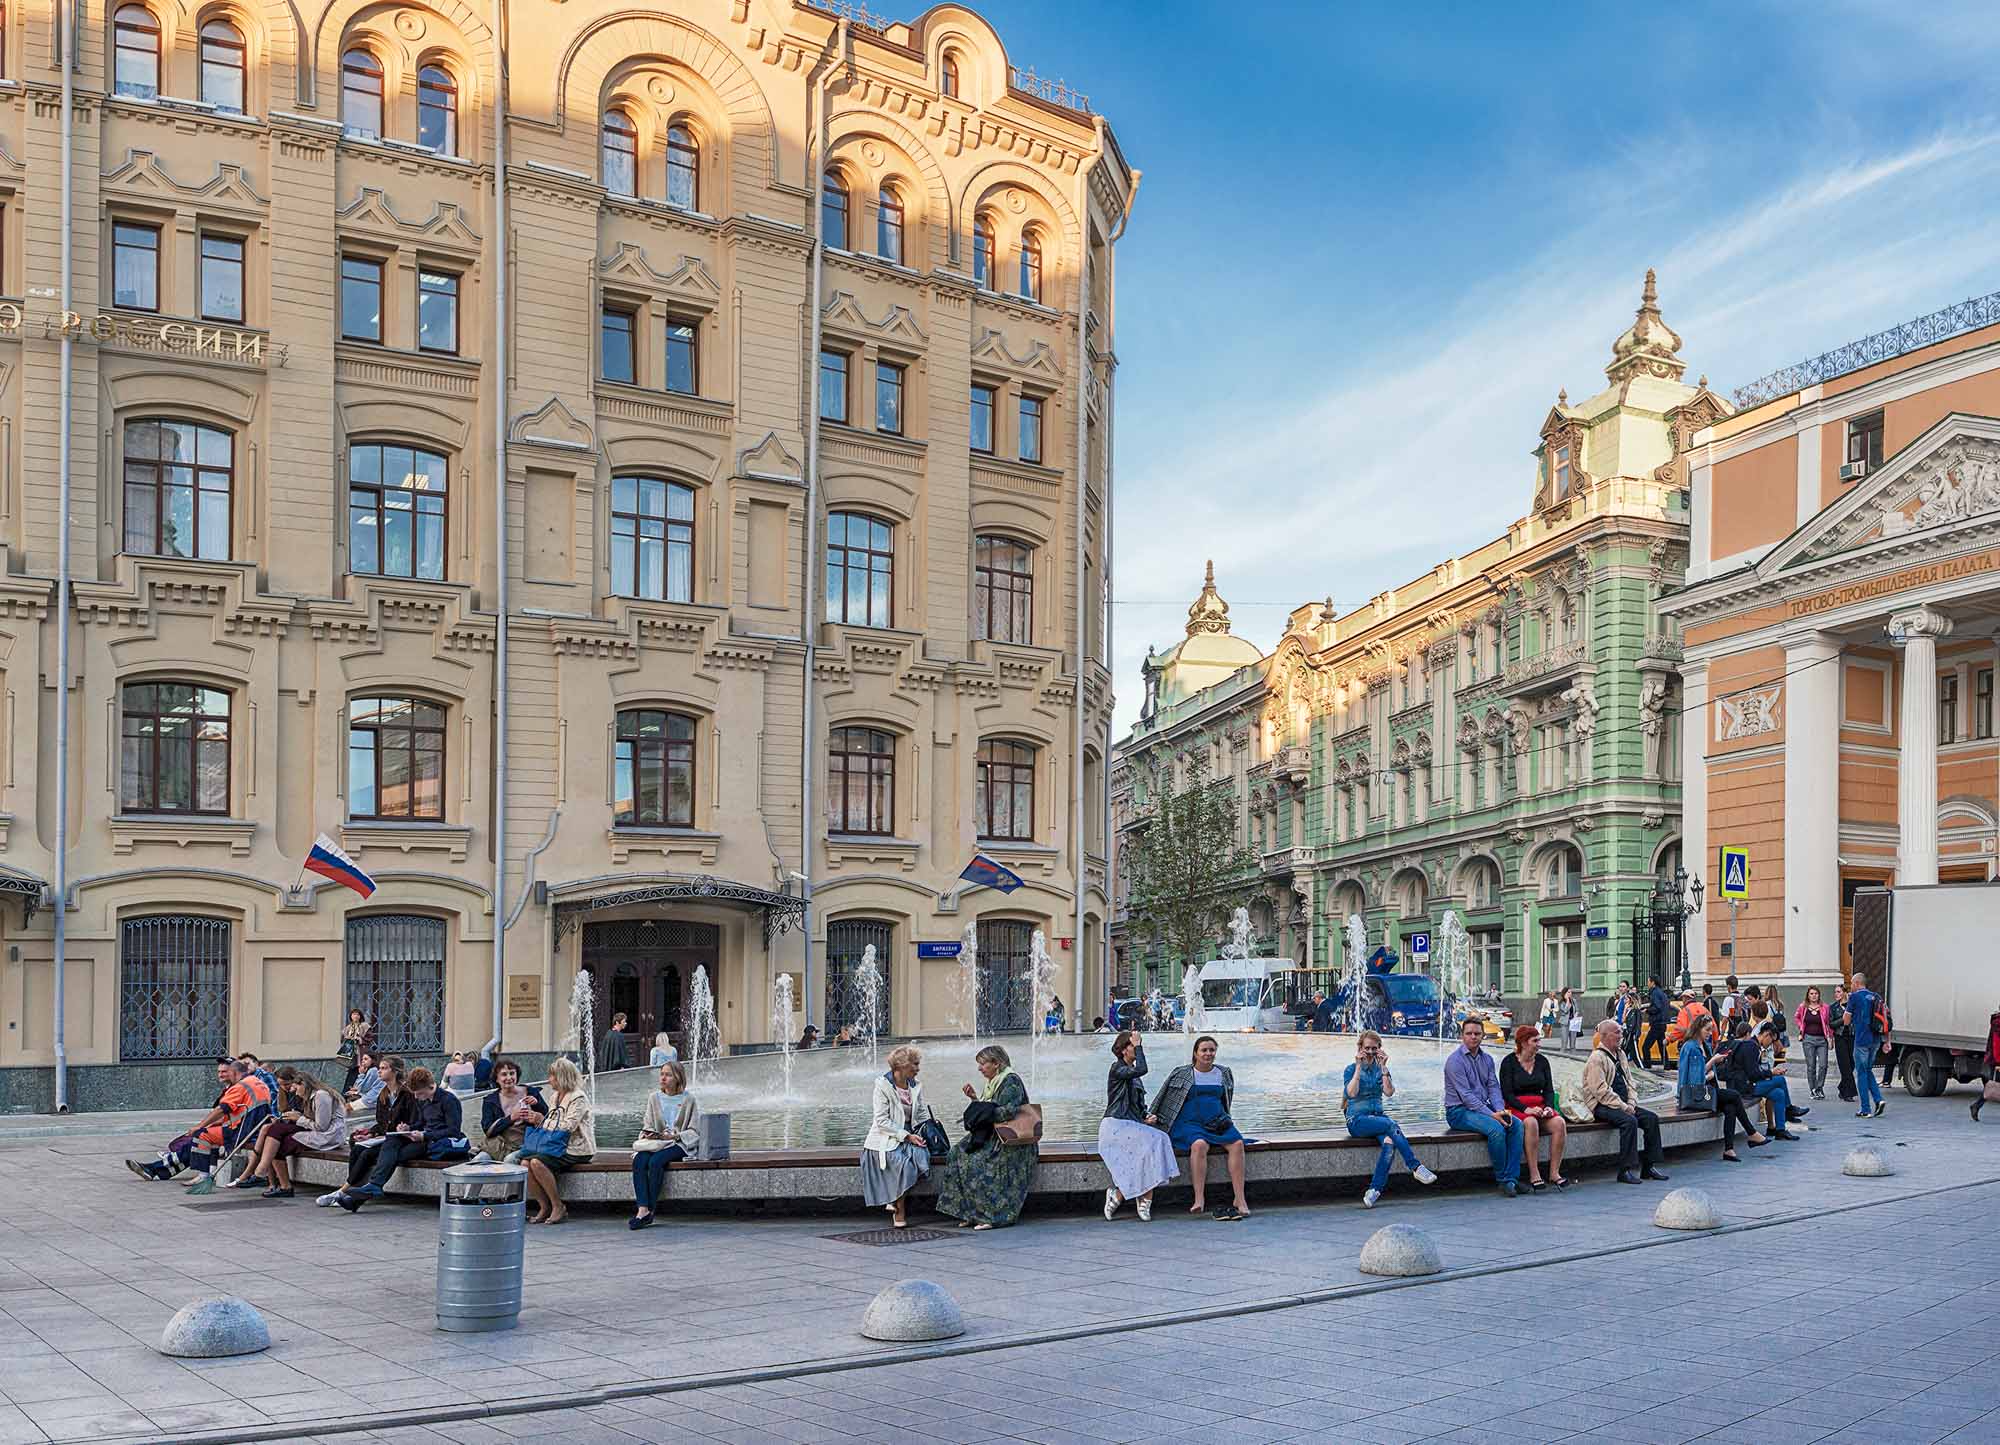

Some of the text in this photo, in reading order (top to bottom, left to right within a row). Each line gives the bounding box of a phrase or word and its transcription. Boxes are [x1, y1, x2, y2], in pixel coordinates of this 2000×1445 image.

[61, 310, 263, 359] РОССИИ
[1791, 567, 1937, 615] ТОРГОВО-ПРОМЫШЛЕННАЯ
[1941, 553, 1993, 578] ПАЛАТА
[1416, 936, 1426, 951] P
